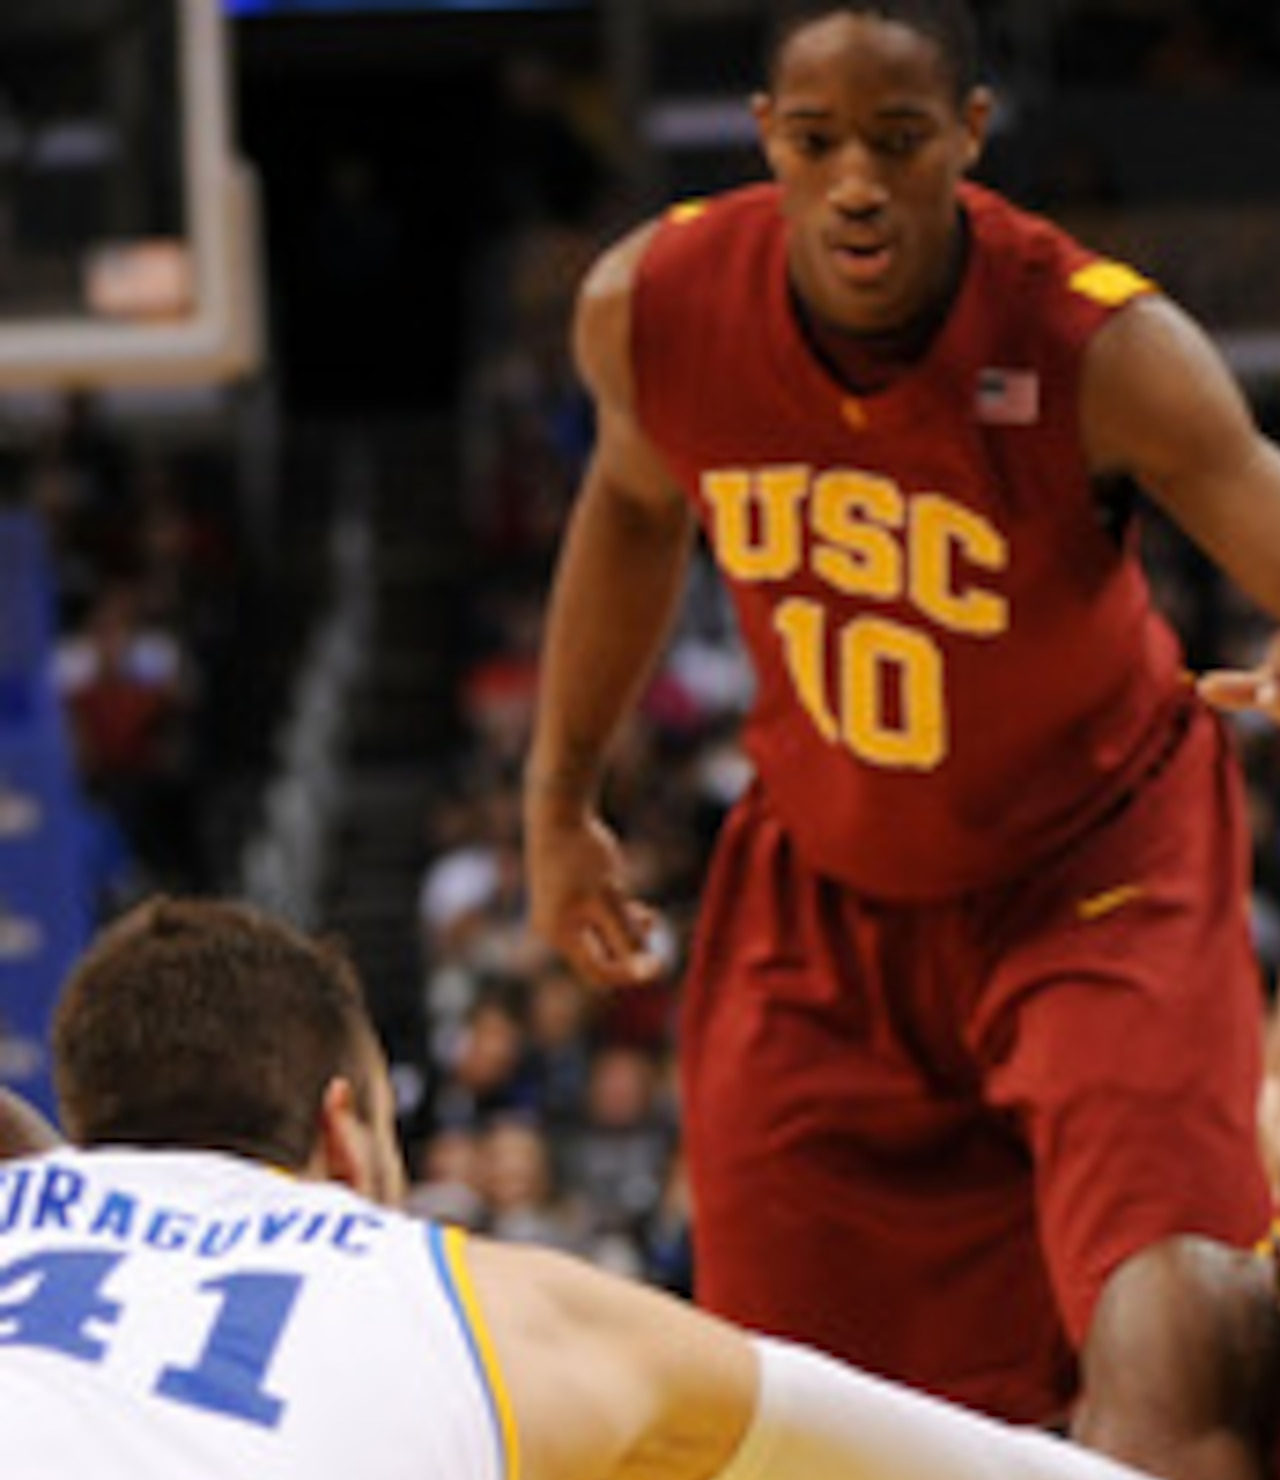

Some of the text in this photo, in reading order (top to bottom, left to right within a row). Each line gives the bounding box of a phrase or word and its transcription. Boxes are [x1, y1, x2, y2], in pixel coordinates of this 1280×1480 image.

[702, 463, 1008, 636] USC
[774, 597, 948, 771] 10
[0, 1246, 306, 1431] 41
